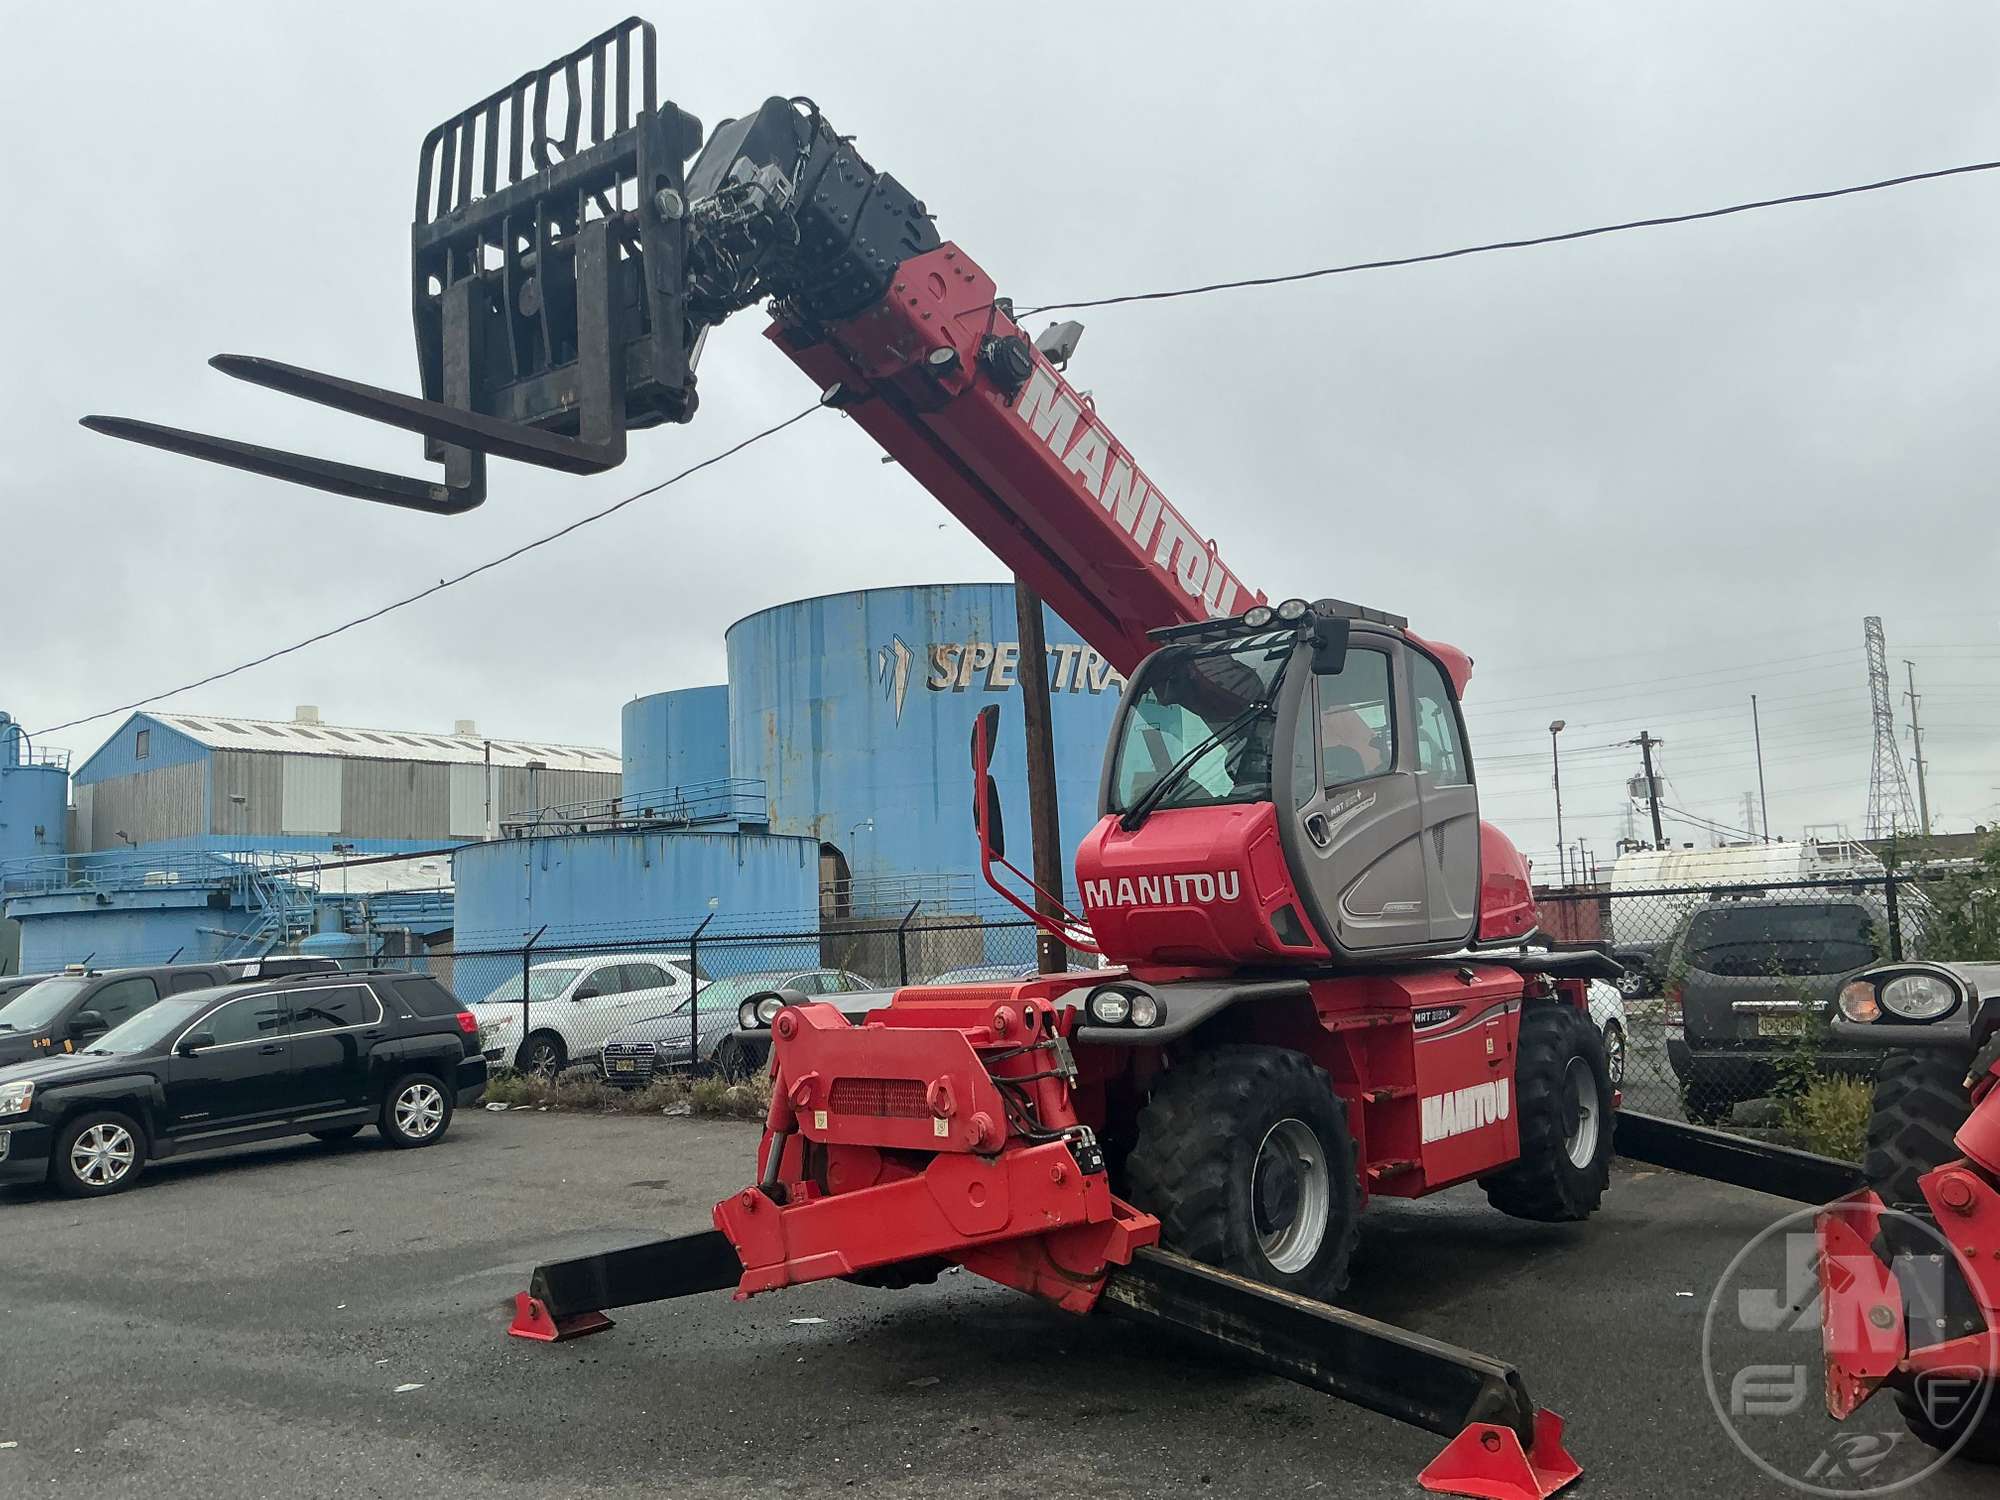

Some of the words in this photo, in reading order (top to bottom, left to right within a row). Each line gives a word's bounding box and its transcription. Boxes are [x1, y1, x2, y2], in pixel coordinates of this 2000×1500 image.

[1017, 362, 1239, 619] MANITOU
[926, 641, 1129, 695] SPETRA
[1084, 870, 1240, 908] MANITOU
[1414, 1011, 1431, 1023] MRT
[1421, 1077, 1509, 1144] MANITOU
